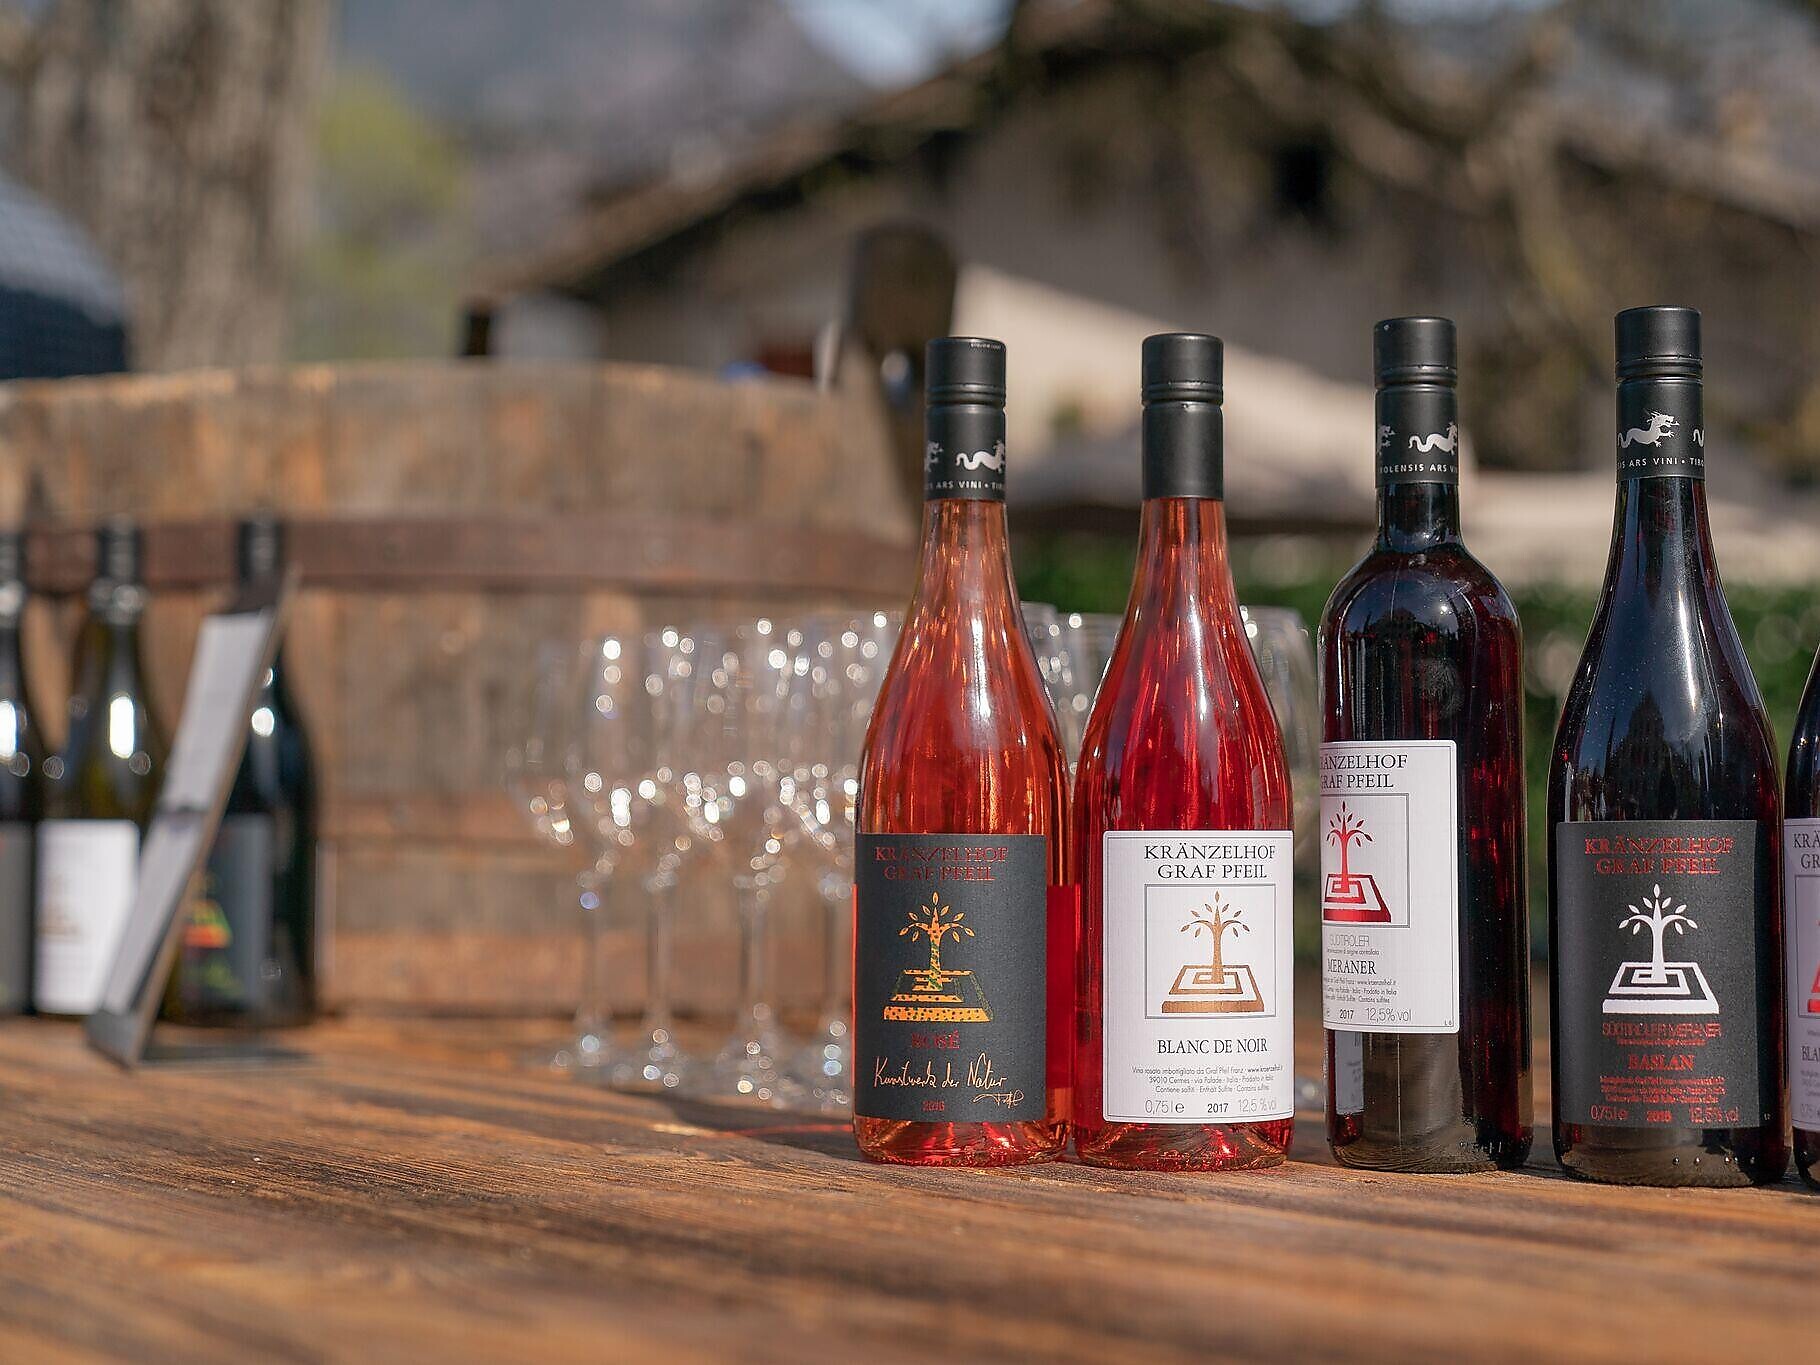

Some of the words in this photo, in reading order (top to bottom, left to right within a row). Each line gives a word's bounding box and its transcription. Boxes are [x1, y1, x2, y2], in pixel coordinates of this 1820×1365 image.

[1430, 464, 1447, 472] ARS
[1629, 458, 1647, 467] ARS
[1653, 457, 1677, 465] VINI
[936, 481, 954, 489] ARS
[959, 480, 981, 489] VINI
[1346, 774, 1394, 788] PFEIL
[1144, 843, 1275, 860] KRÄNZELHOF
[1585, 836, 1734, 854] KRÄNZELHOF
[1158, 864, 1216, 879] GRAF
[1222, 864, 1267, 879] PFEIL
[1597, 858, 1655, 874] GRAF
[1661, 858, 1720, 874] PFEIL
[1328, 958, 1377, 974] MERANER
[1340, 1009, 1354, 1020] 2017
[1157, 1039, 1210, 1054] BLANC
[1214, 1039, 1232, 1054] DE
[1237, 1038, 1268, 1053] NOIR
[1207, 1103, 1229, 1113] 2017
